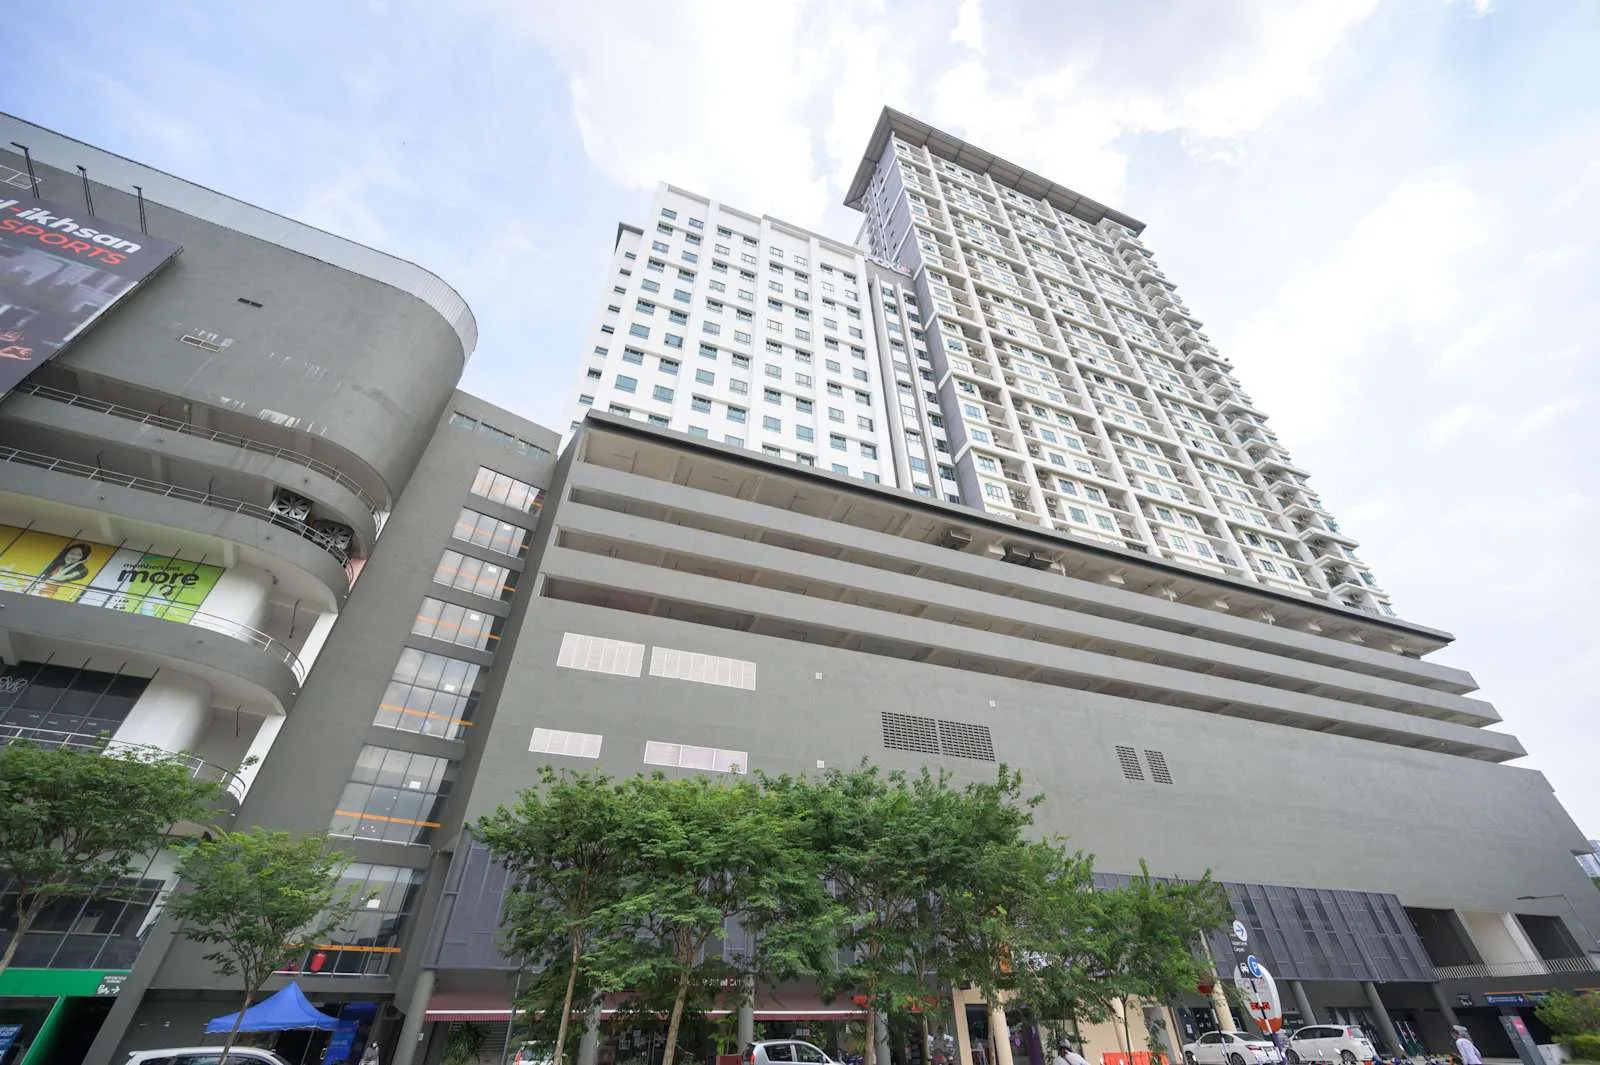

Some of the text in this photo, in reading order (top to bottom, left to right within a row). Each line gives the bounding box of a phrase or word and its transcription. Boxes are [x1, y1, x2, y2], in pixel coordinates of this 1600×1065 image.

[0, 198, 142, 254] l-ikhsan
[0, 219, 127, 265] SPORTS
[118, 569, 200, 585] more
